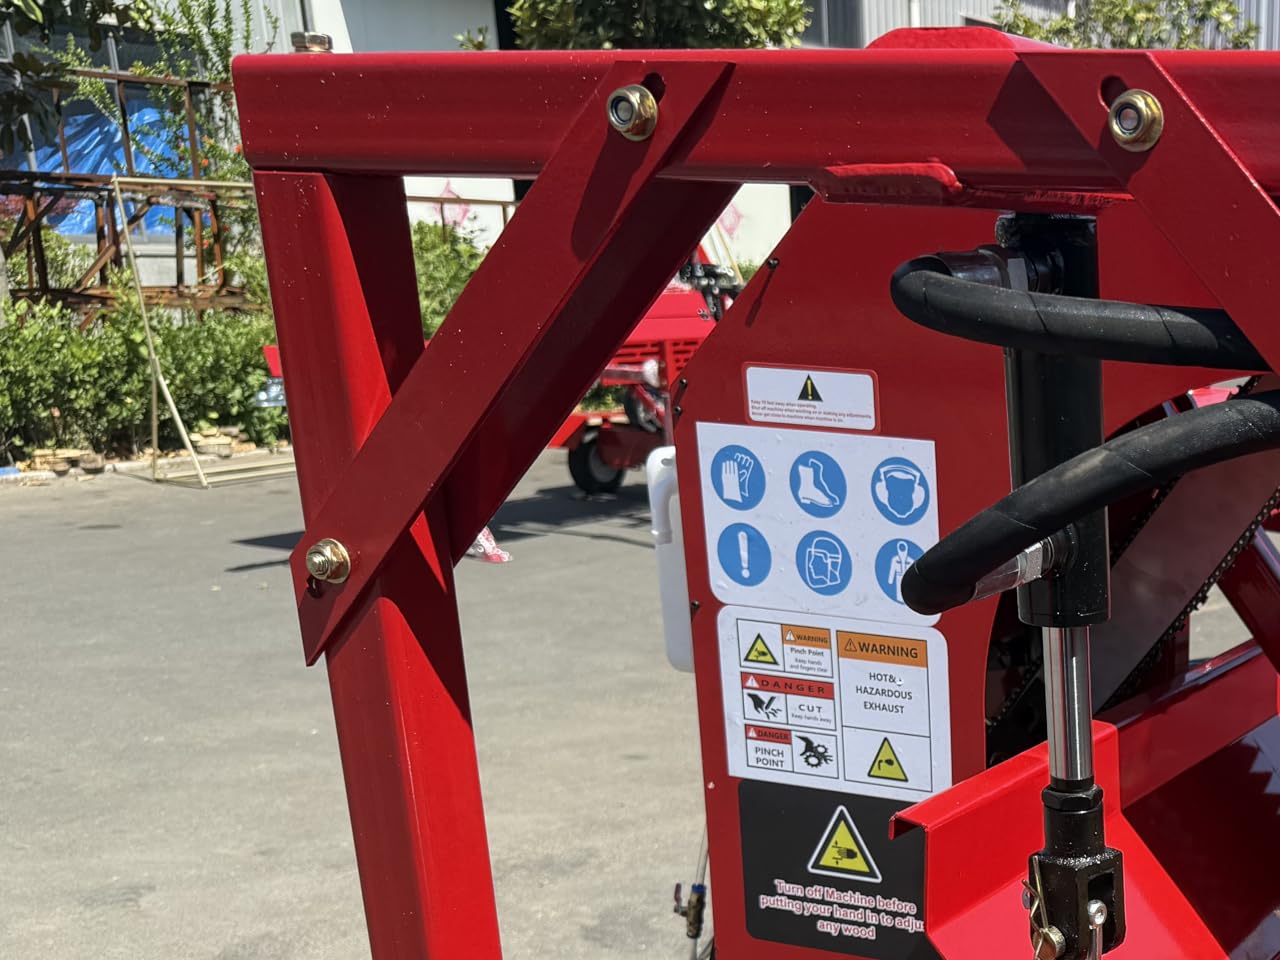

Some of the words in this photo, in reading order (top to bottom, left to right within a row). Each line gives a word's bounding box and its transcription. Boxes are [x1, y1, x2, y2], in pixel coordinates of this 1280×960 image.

[796, 634, 828, 644] WARNING
[858, 641, 918, 659] WARNING
[869, 672, 897, 684] HOT&
[761, 679, 825, 694] DANGER
[856, 685, 913, 700] HAZARDOUS
[798, 704, 823, 713] CUT
[863, 701, 905, 714] EXHAUST
[755, 746, 784, 758] PINCH
[755, 757, 785, 768] POINT
[774, 879, 804, 896] Turn
[806, 886, 823, 899] off
[824, 889, 875, 908] Machine
[876, 895, 917, 914] before
[760, 894, 802, 913] putting
[804, 903, 833, 917] your
[833, 904, 865, 922] hand
[865, 910, 879, 924] in
[880, 912, 894, 927] to
[895, 916, 924, 933] adju
[817, 919, 841, 936] any
[841, 923, 876, 940] wood
